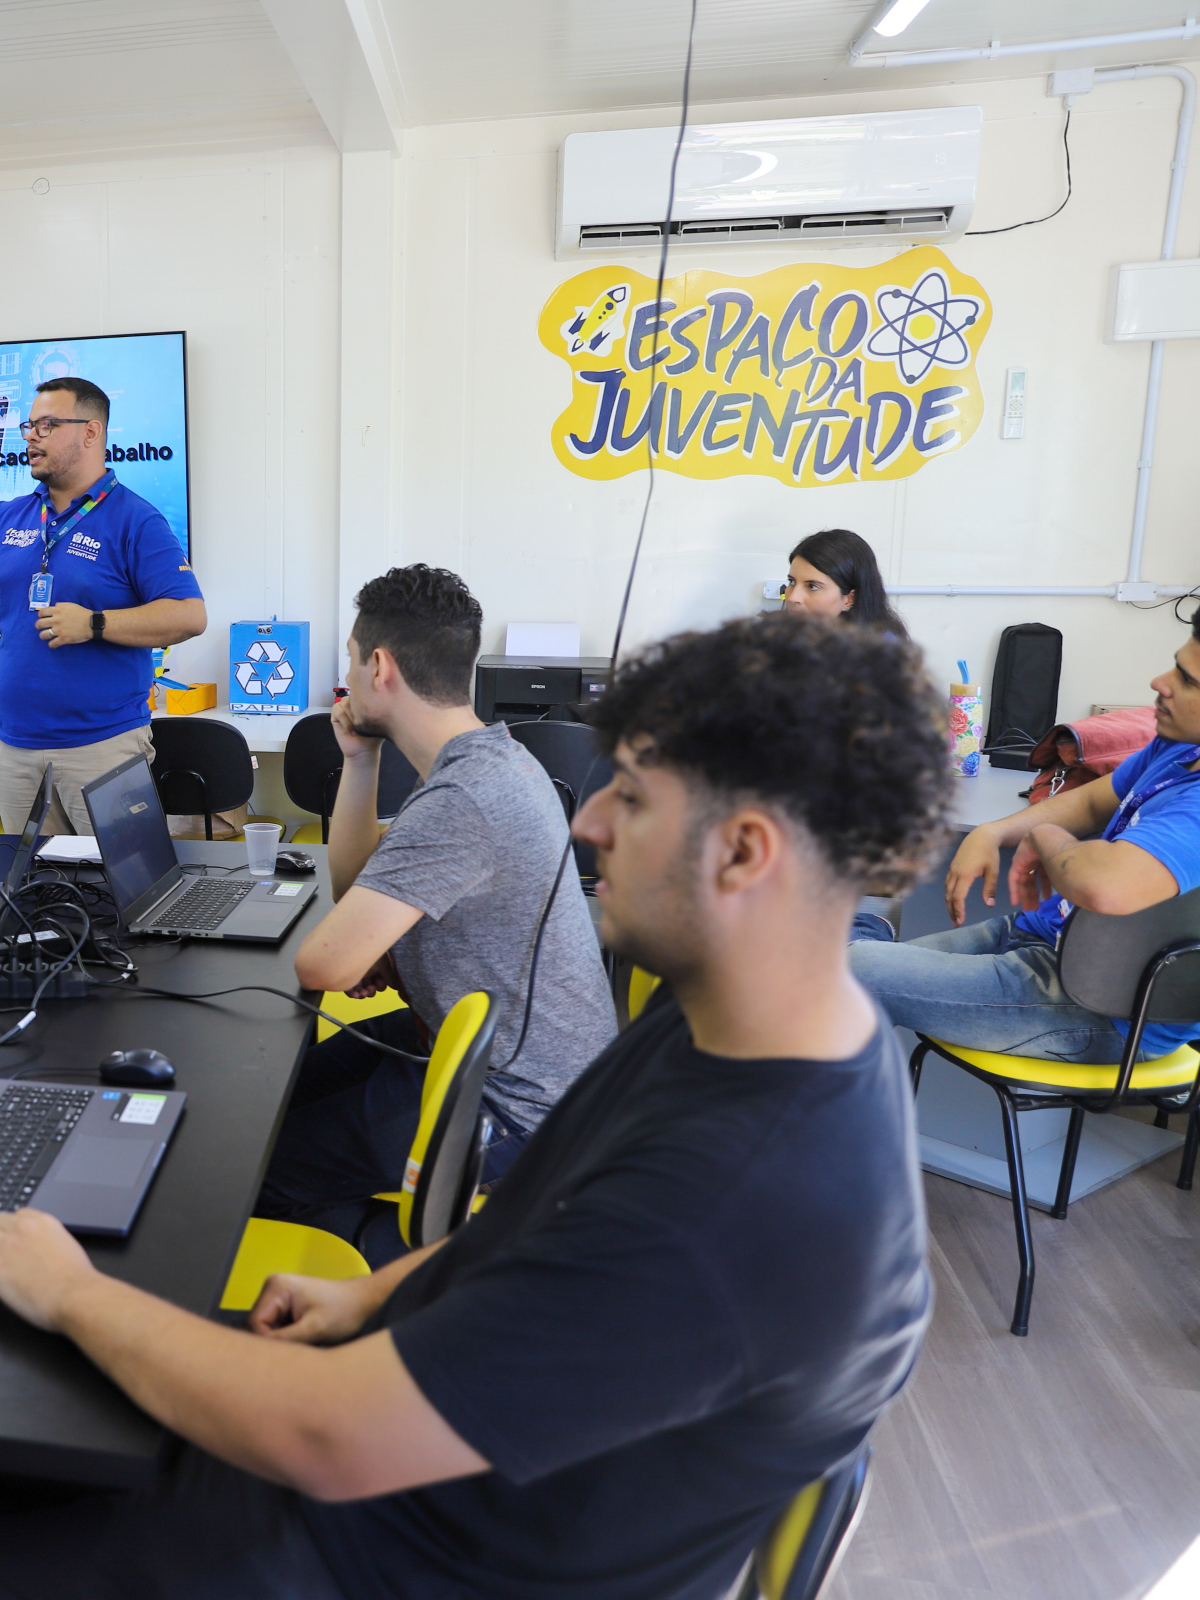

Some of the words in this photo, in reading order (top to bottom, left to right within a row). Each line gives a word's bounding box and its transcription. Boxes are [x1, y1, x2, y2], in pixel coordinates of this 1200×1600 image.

[627, 282, 870, 389] ESPAÇO
[803, 357, 866, 407] DA
[567, 368, 967, 481] JUVENTUDE
[104, 443, 173, 463] abalho
[66, 548, 97, 562] JUVENTUDE
[82, 535, 102, 550] Rio
